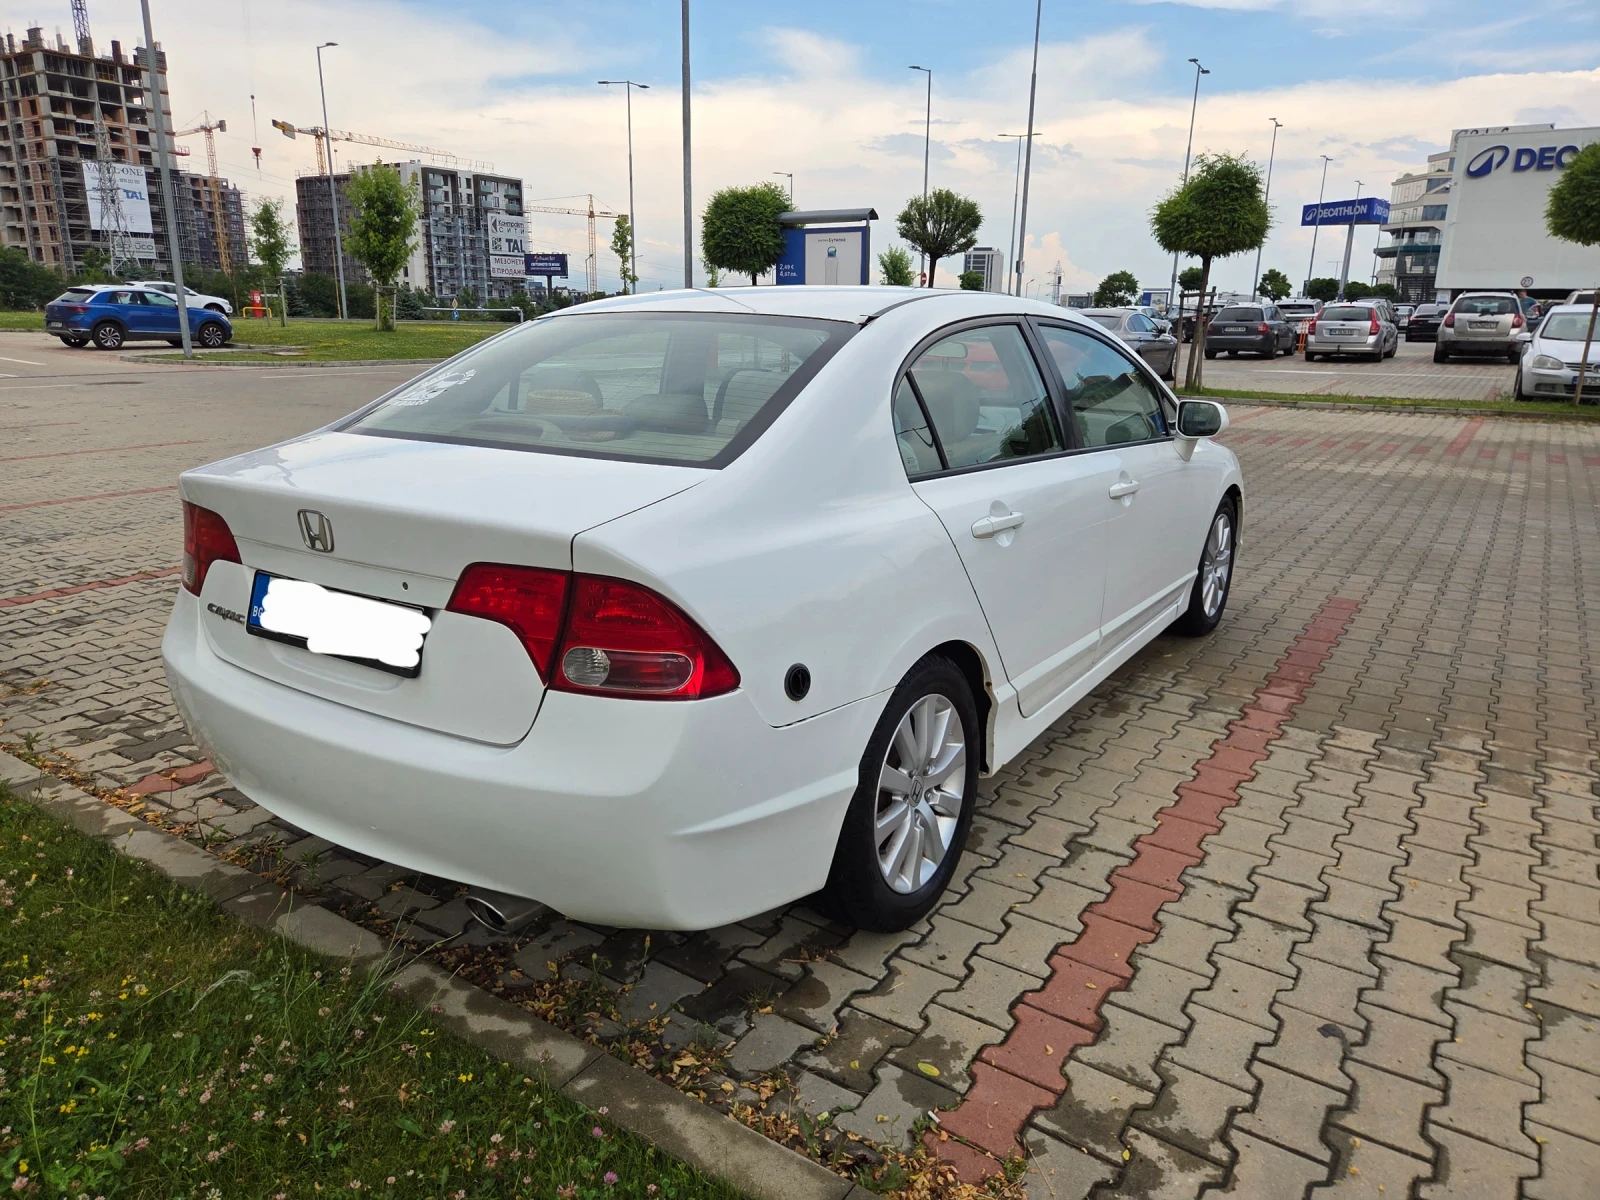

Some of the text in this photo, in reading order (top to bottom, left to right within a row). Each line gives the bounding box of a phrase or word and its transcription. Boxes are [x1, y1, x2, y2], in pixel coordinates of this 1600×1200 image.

[1512, 145, 1580, 172] DEC
[122, 188, 146, 201] TAL
[1318, 204, 1368, 219] DECATHLON
[505, 238, 526, 254] TAL
